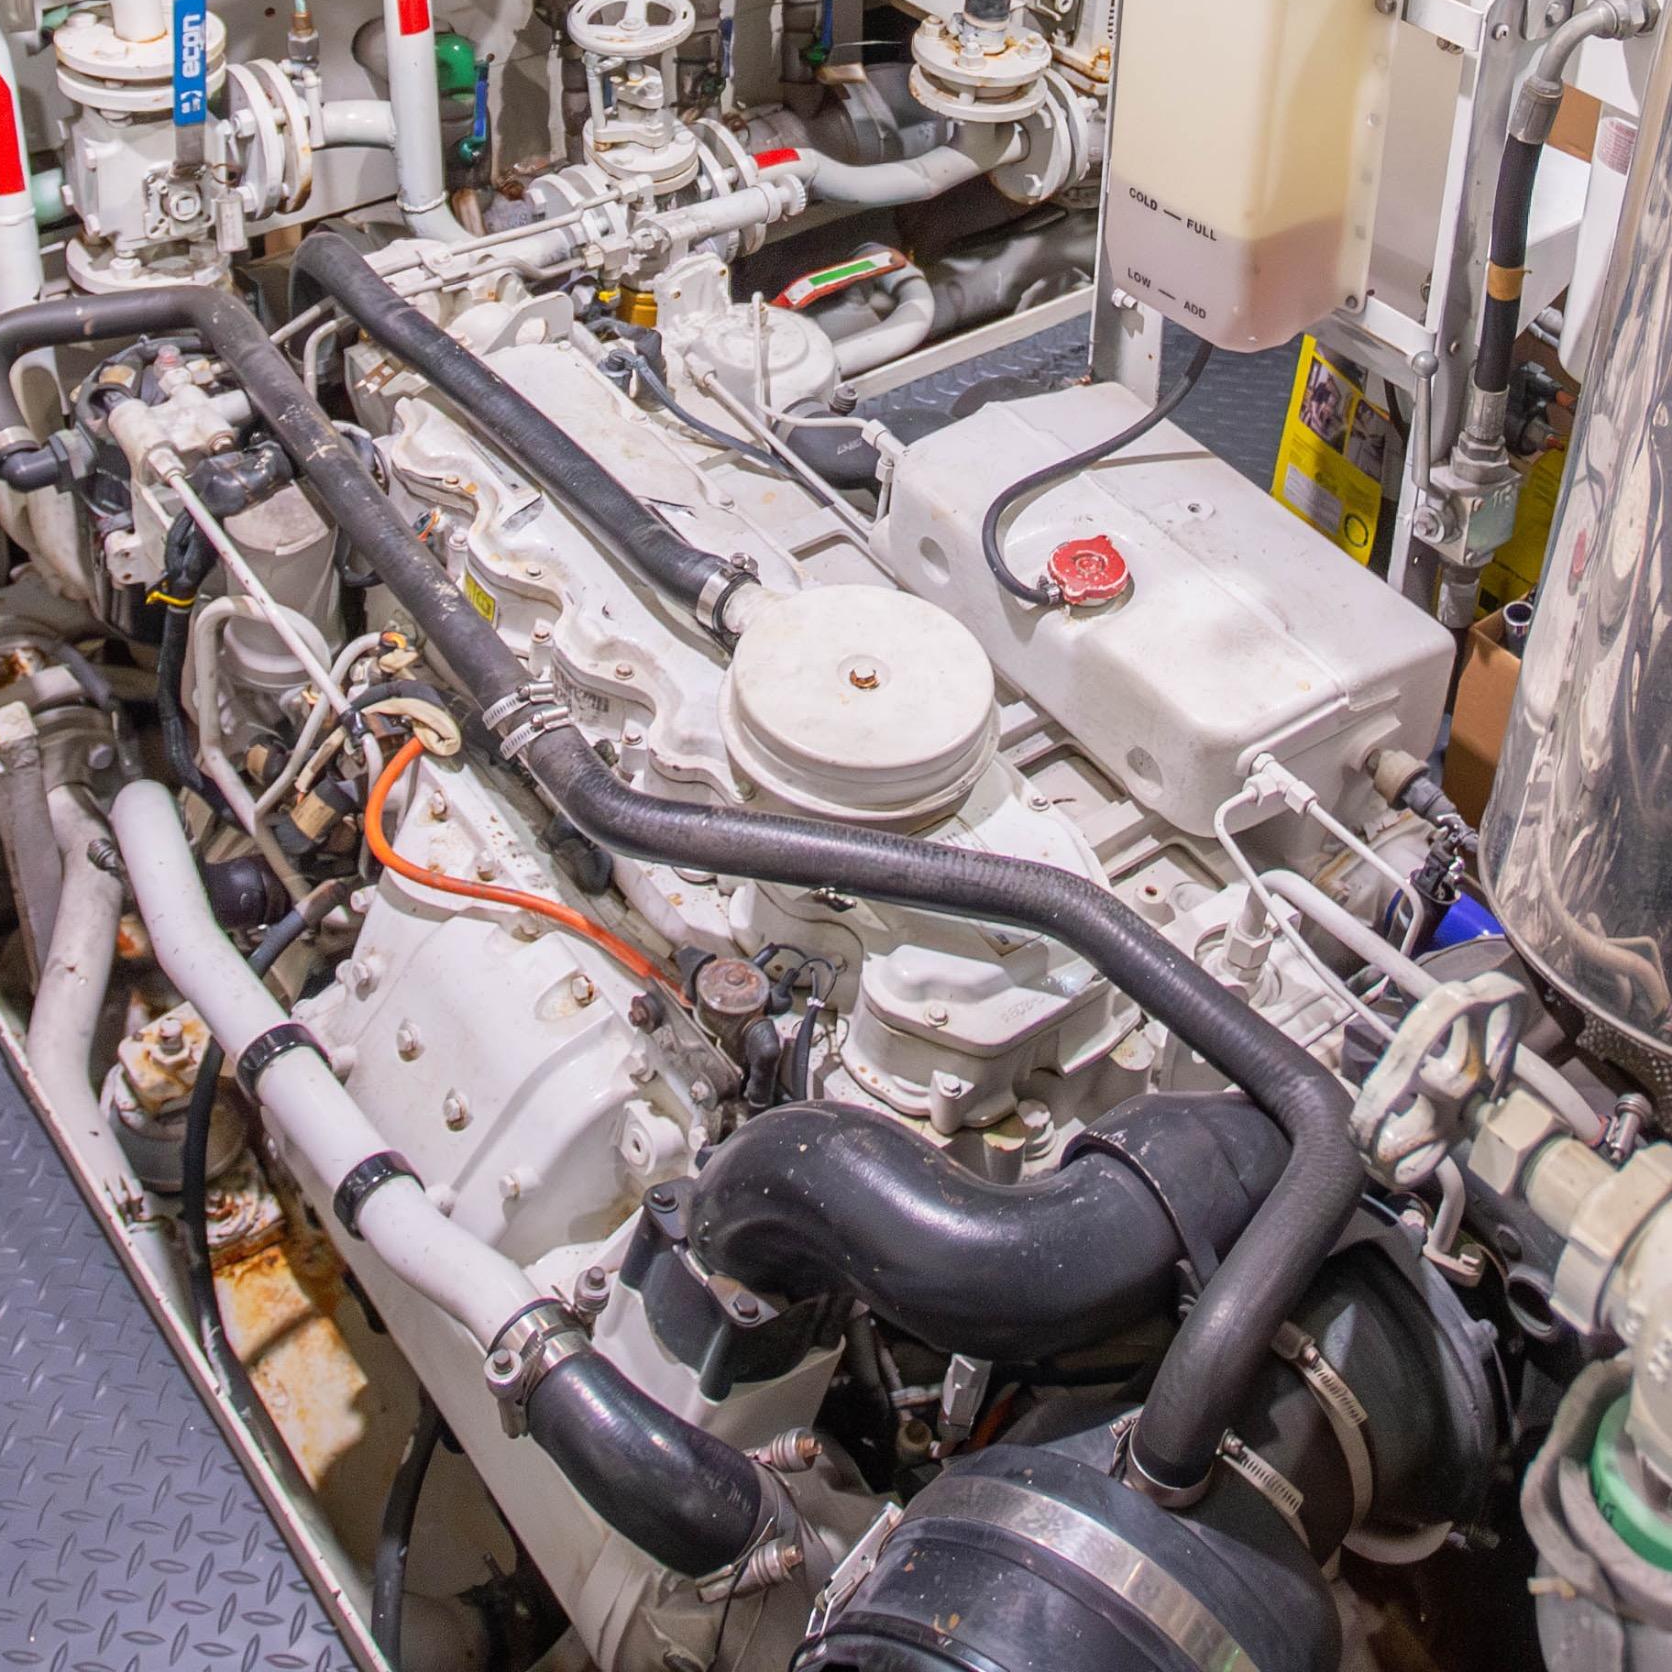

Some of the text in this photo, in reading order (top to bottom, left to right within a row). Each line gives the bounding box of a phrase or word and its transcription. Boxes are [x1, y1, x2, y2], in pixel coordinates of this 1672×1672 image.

[182, 13, 201, 79] econ
[1128, 187, 1217, 242] COLD FULL
[1127, 267, 1207, 319] LOW ADD
